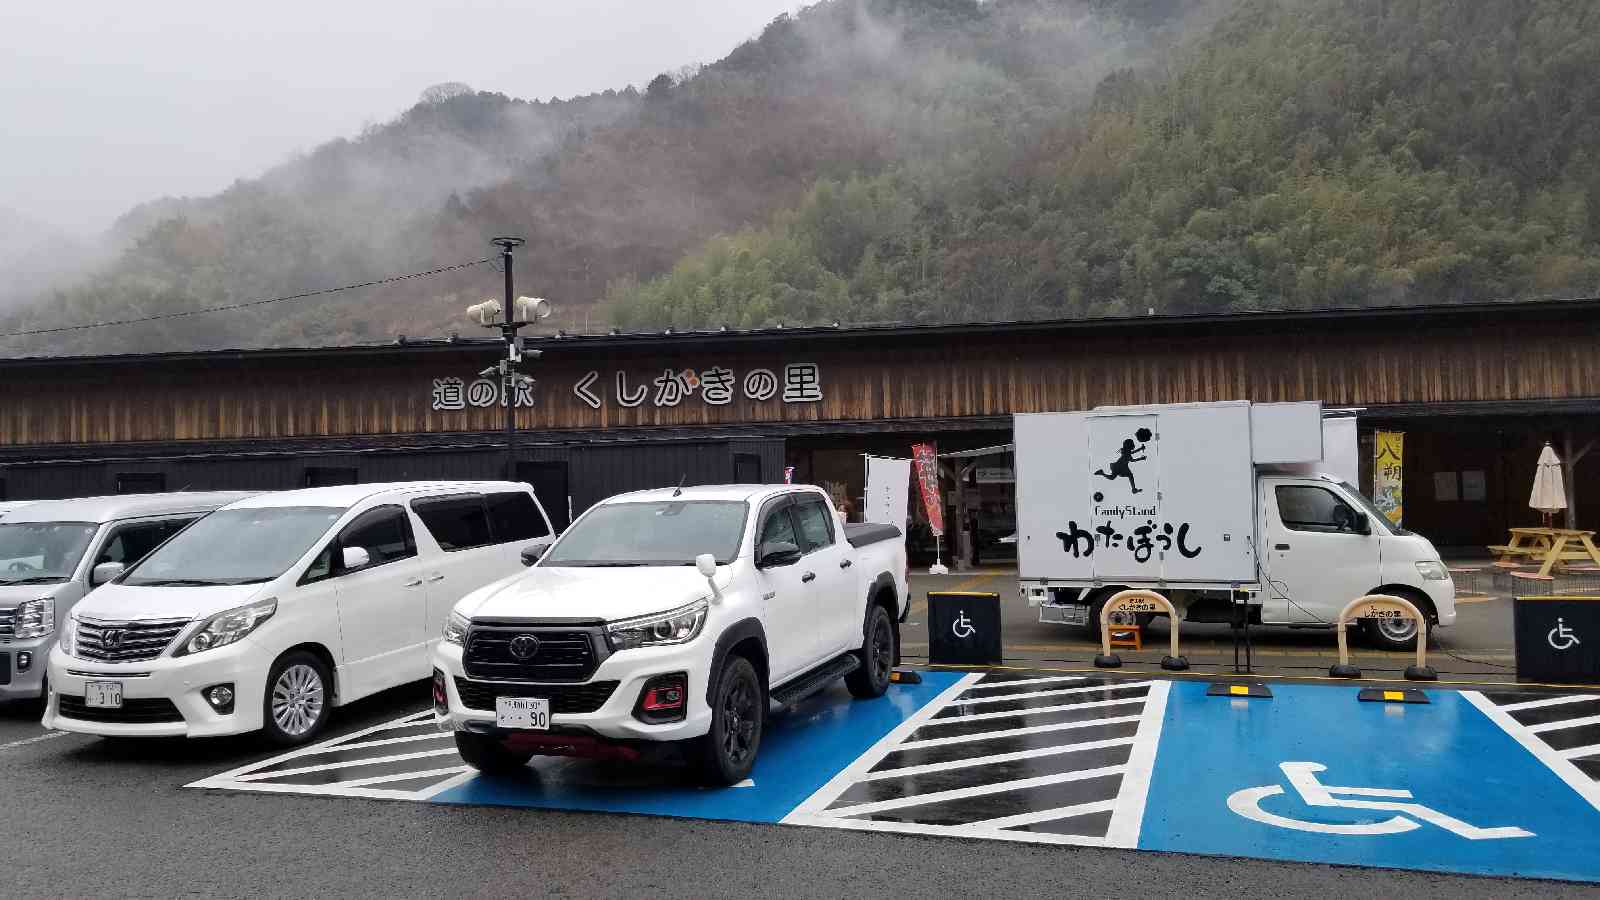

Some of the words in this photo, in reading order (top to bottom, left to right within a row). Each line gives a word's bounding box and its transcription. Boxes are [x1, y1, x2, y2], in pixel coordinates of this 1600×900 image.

[574, 363, 823, 408] くしがきの里
[1055, 519, 1202, 563] わたぼうし
